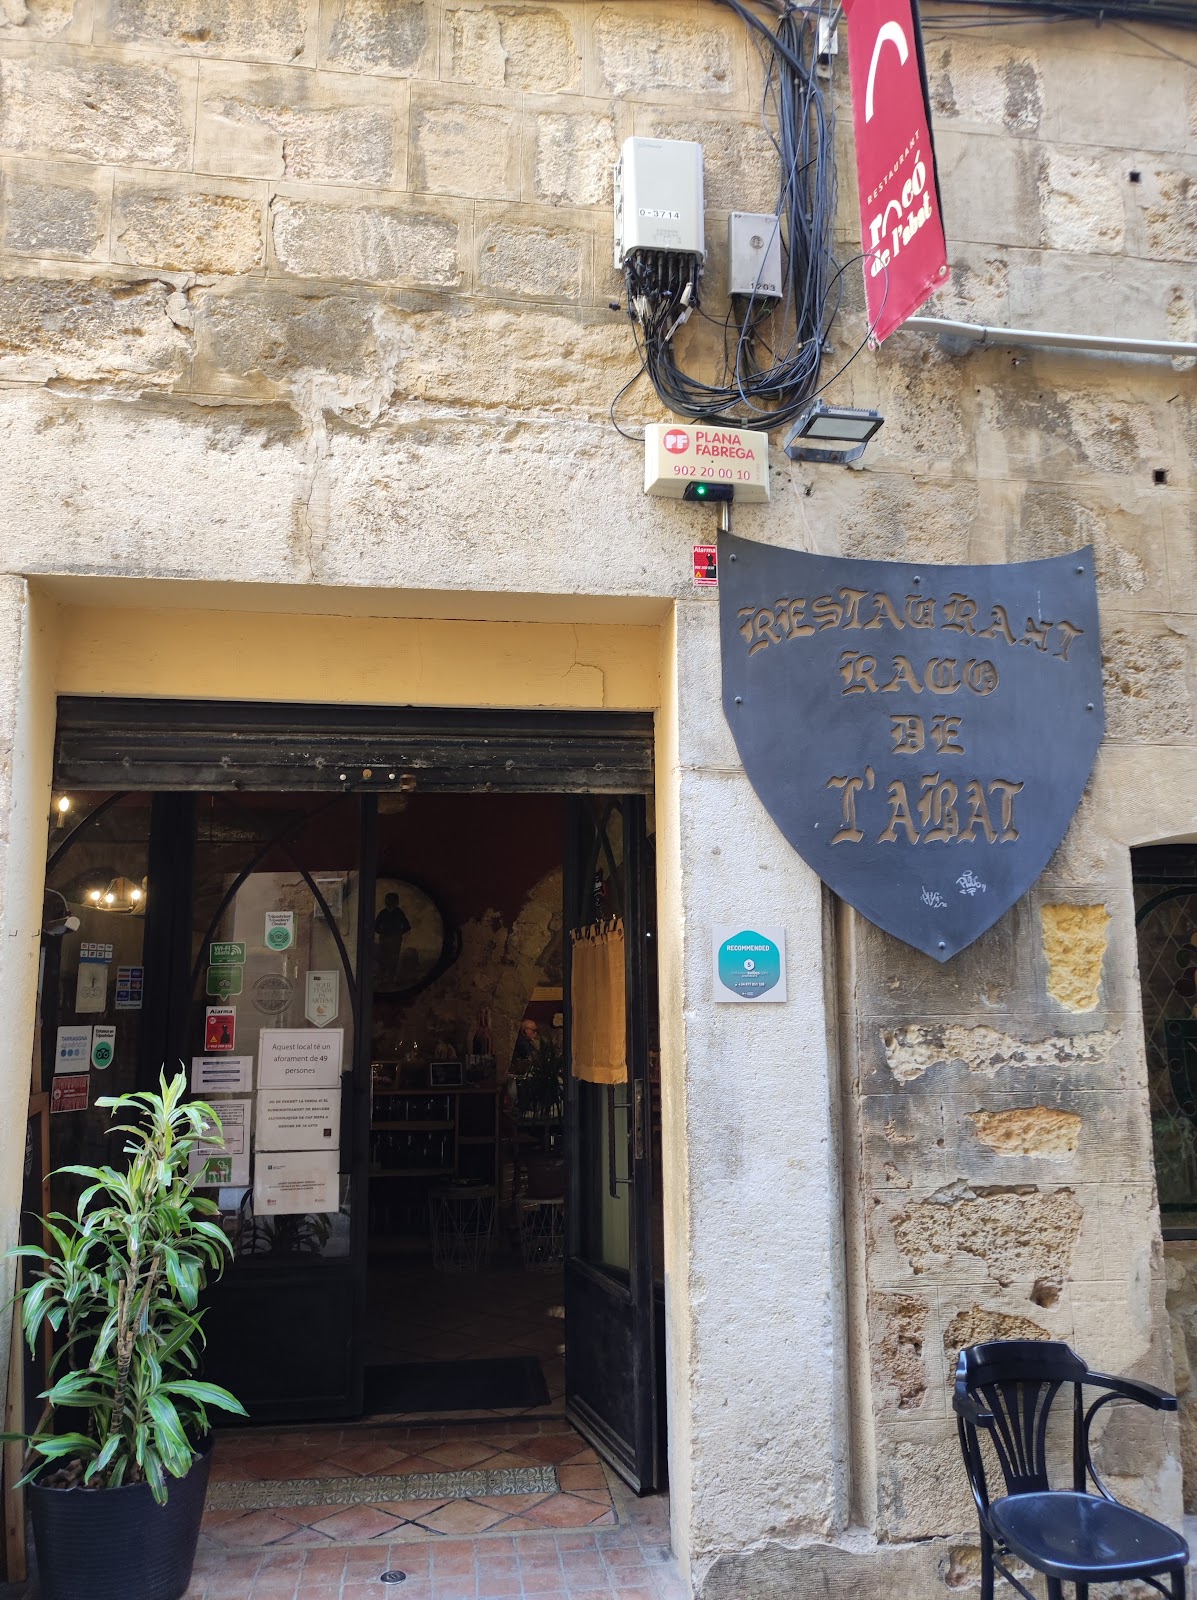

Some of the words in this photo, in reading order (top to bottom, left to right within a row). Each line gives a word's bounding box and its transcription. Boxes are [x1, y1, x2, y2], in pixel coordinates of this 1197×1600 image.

[867, 129, 920, 205] RESTAURANT
[695, 431, 742, 446] PLANA
[695, 444, 755, 461] FABREGA
[673, 465, 696, 476] 902
[700, 466, 714, 477] 20
[718, 468, 733, 479] 00
[737, 470, 750, 480] 10
[737, 586, 1085, 662] RESTAURANT
[839, 649, 1000, 696] RACO
[889, 714, 965, 755] DE
[726, 944, 770, 952] RECOMMENDED
[271, 1043, 295, 1051] Aquest
